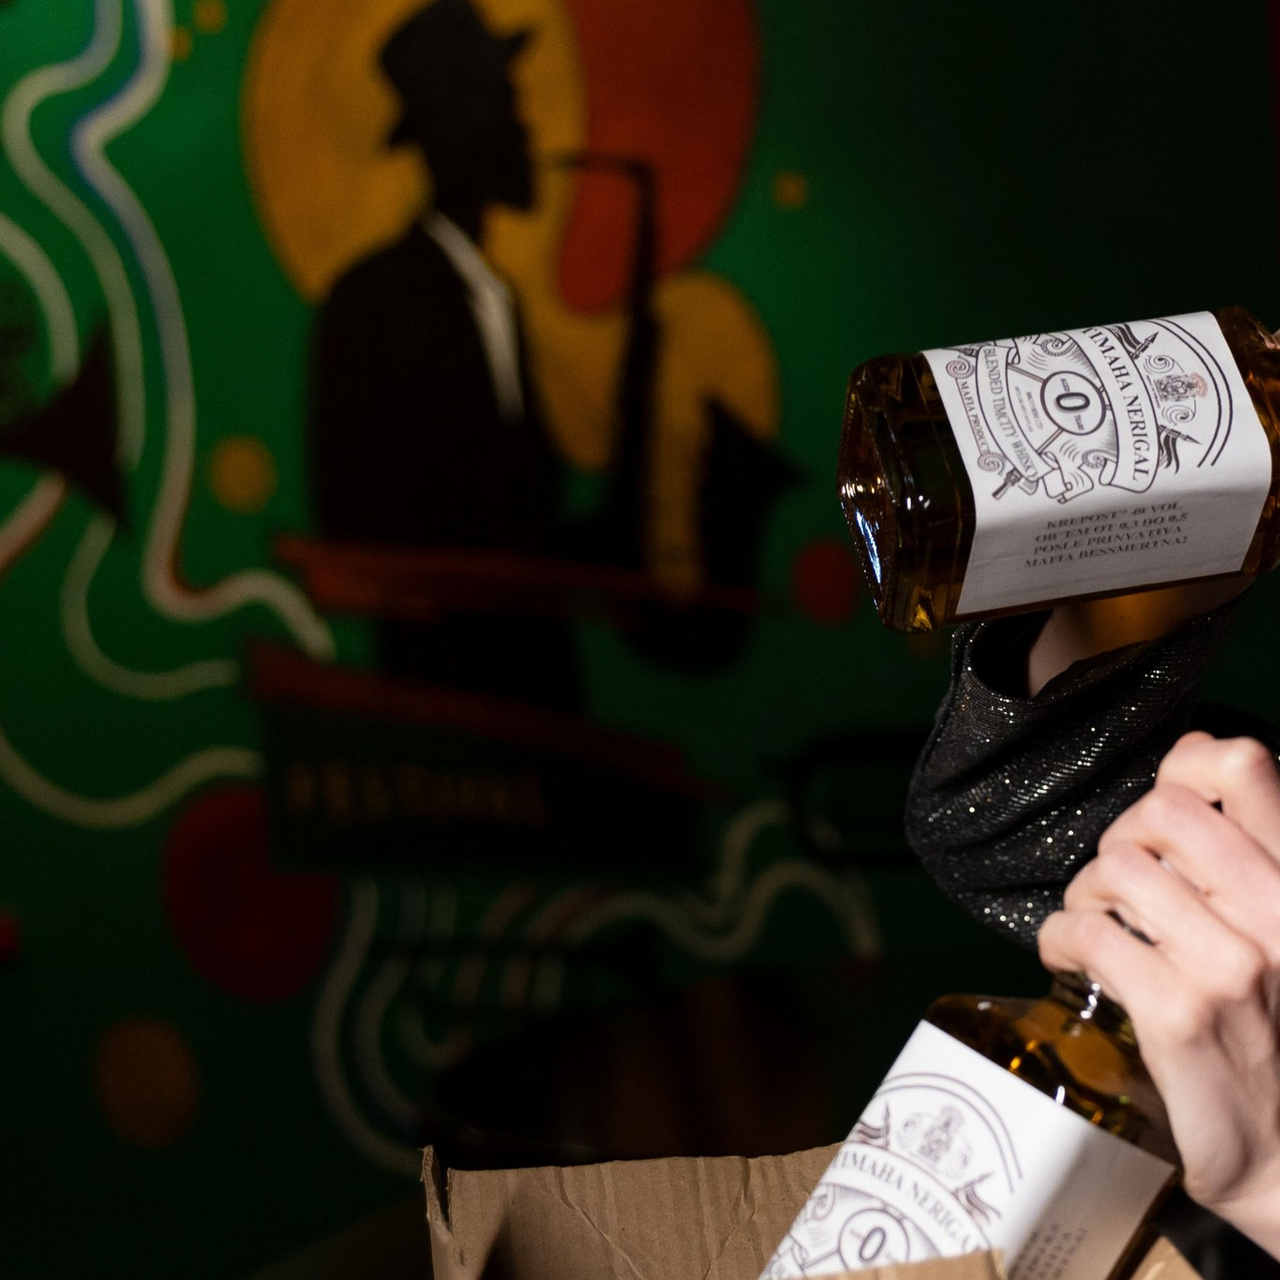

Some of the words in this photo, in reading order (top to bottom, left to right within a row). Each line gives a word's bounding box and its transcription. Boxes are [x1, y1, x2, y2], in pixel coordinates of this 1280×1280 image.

[984, 348, 1003, 394] BLENDED
[961, 381, 976, 412] MAFIA
[1056, 392, 1090, 411] 0
[993, 397, 1018, 438] TIMCITY
[1123, 395, 1150, 480] NERIGAL
